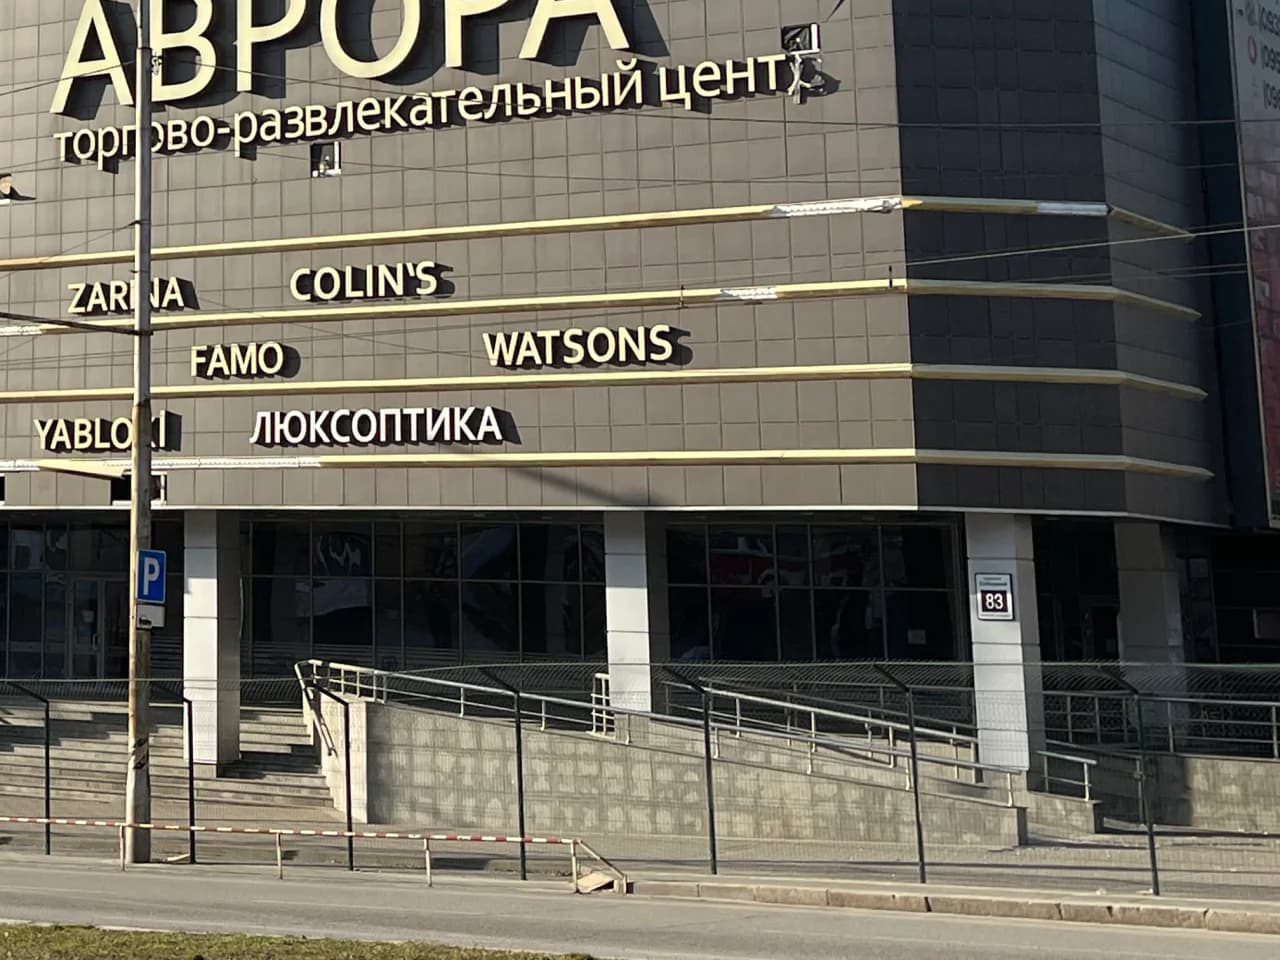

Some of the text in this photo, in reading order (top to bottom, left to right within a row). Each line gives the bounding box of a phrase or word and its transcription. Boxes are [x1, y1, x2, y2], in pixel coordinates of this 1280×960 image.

[660, 52, 800, 110] цент
[290, 261, 438, 301] COLIN'S
[191, 341, 284, 377] FAMO
[482, 324, 673, 366] WATSONS
[34, 409, 166, 450] YABLOI
[250, 406, 503, 444] ЛЮКСОПТИКА
[143, 556, 160, 596] P
[985, 592, 1004, 610] 83
